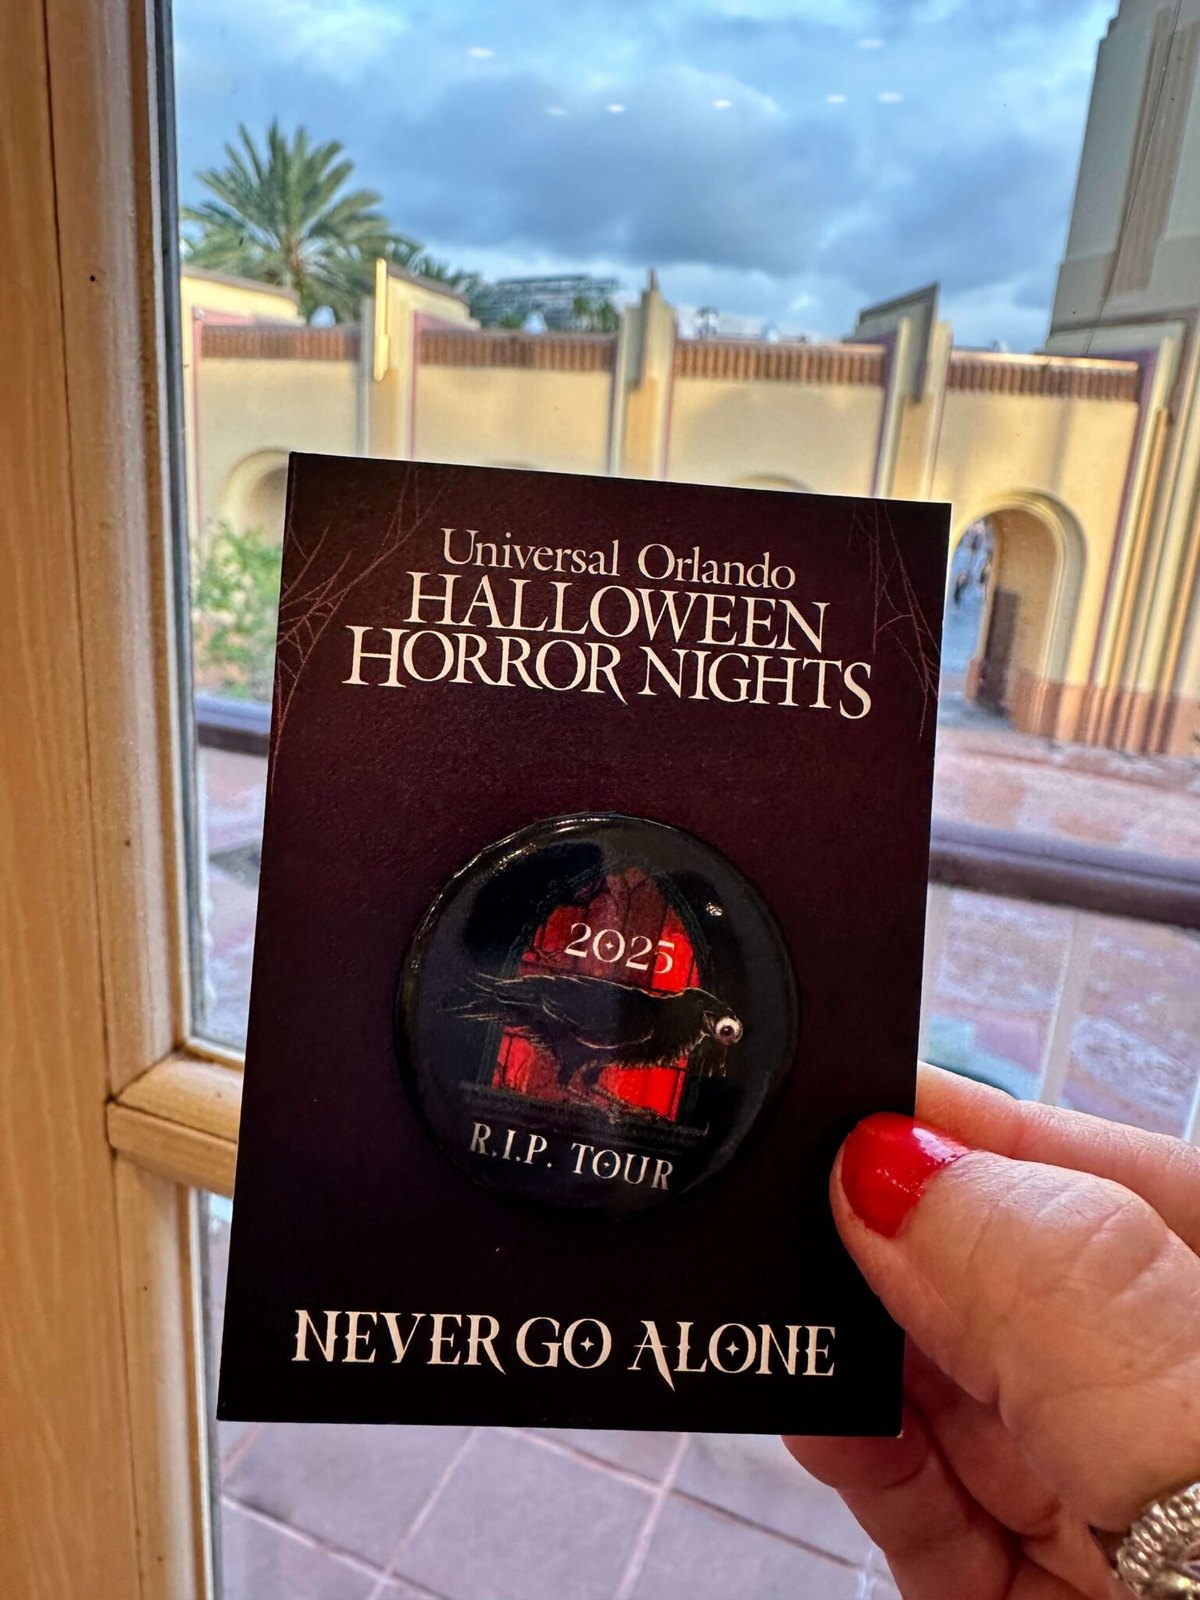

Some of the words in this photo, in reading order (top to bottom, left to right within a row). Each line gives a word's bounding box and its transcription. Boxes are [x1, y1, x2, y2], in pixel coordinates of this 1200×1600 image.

[441, 527, 620, 577] Universal
[637, 543, 796, 590] Orlando
[403, 571, 830, 654] HALLOWEEN
[341, 625, 628, 705] HORROR
[637, 646, 872, 720] NIGHTS
[564, 922, 676, 975] 2025
[469, 1121, 554, 1168] R.I.P.
[571, 1142, 675, 1192] TOUR
[292, 1309, 505, 1374] NEVER
[516, 1316, 612, 1370] GO
[628, 1320, 836, 1391] ALONE
